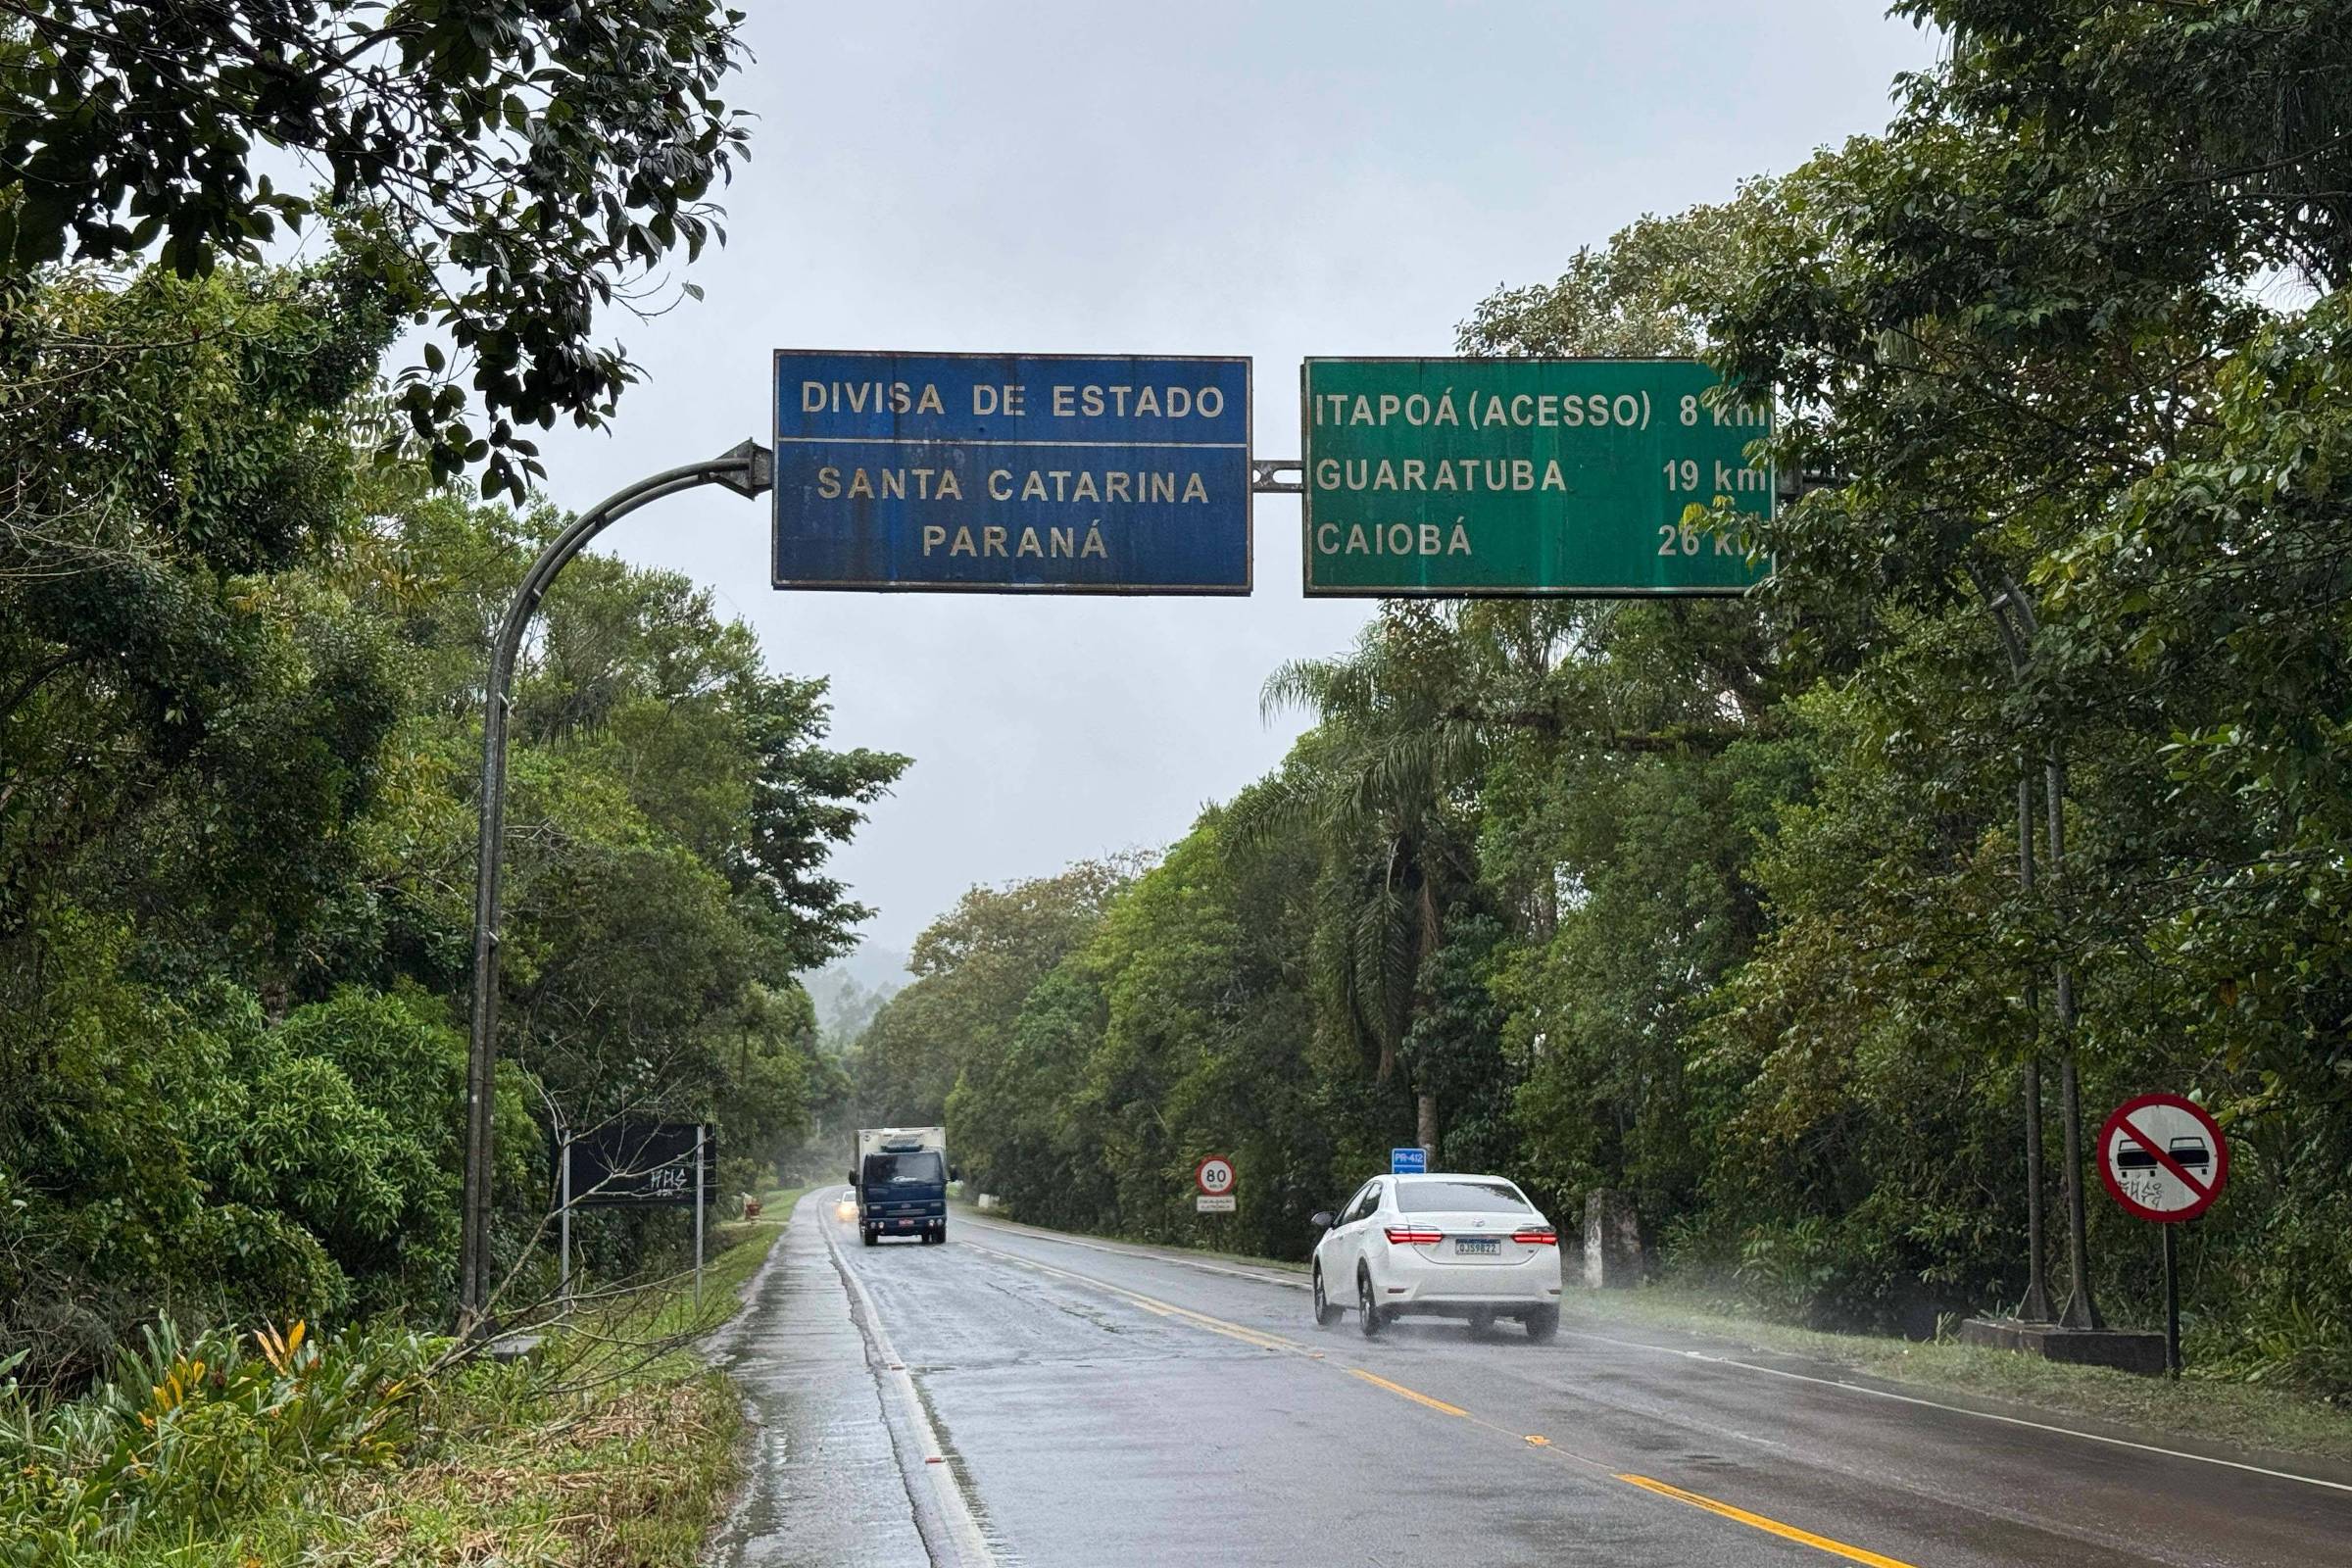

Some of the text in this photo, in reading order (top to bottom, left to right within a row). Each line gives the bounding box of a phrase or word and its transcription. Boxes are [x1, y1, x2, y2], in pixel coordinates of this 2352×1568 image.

[802, 381, 1224, 417] DIVISA DE ESTADO
[1316, 386, 1459, 426] ITAPOÁ
[1469, 390, 1651, 430] (ACESSO)
[1680, 394, 1698, 426] 8
[817, 467, 1209, 504] SANTA CATARINA
[1316, 459, 1766, 491] GUARATUBA 19 km
[923, 518, 1107, 559] PARANÁ
[1316, 516, 1473, 556] CAIOBÁ
[1658, 524, 1699, 556] 26
[1395, 1152, 1423, 1163] PR-412
[1206, 1169, 1227, 1183] 80
